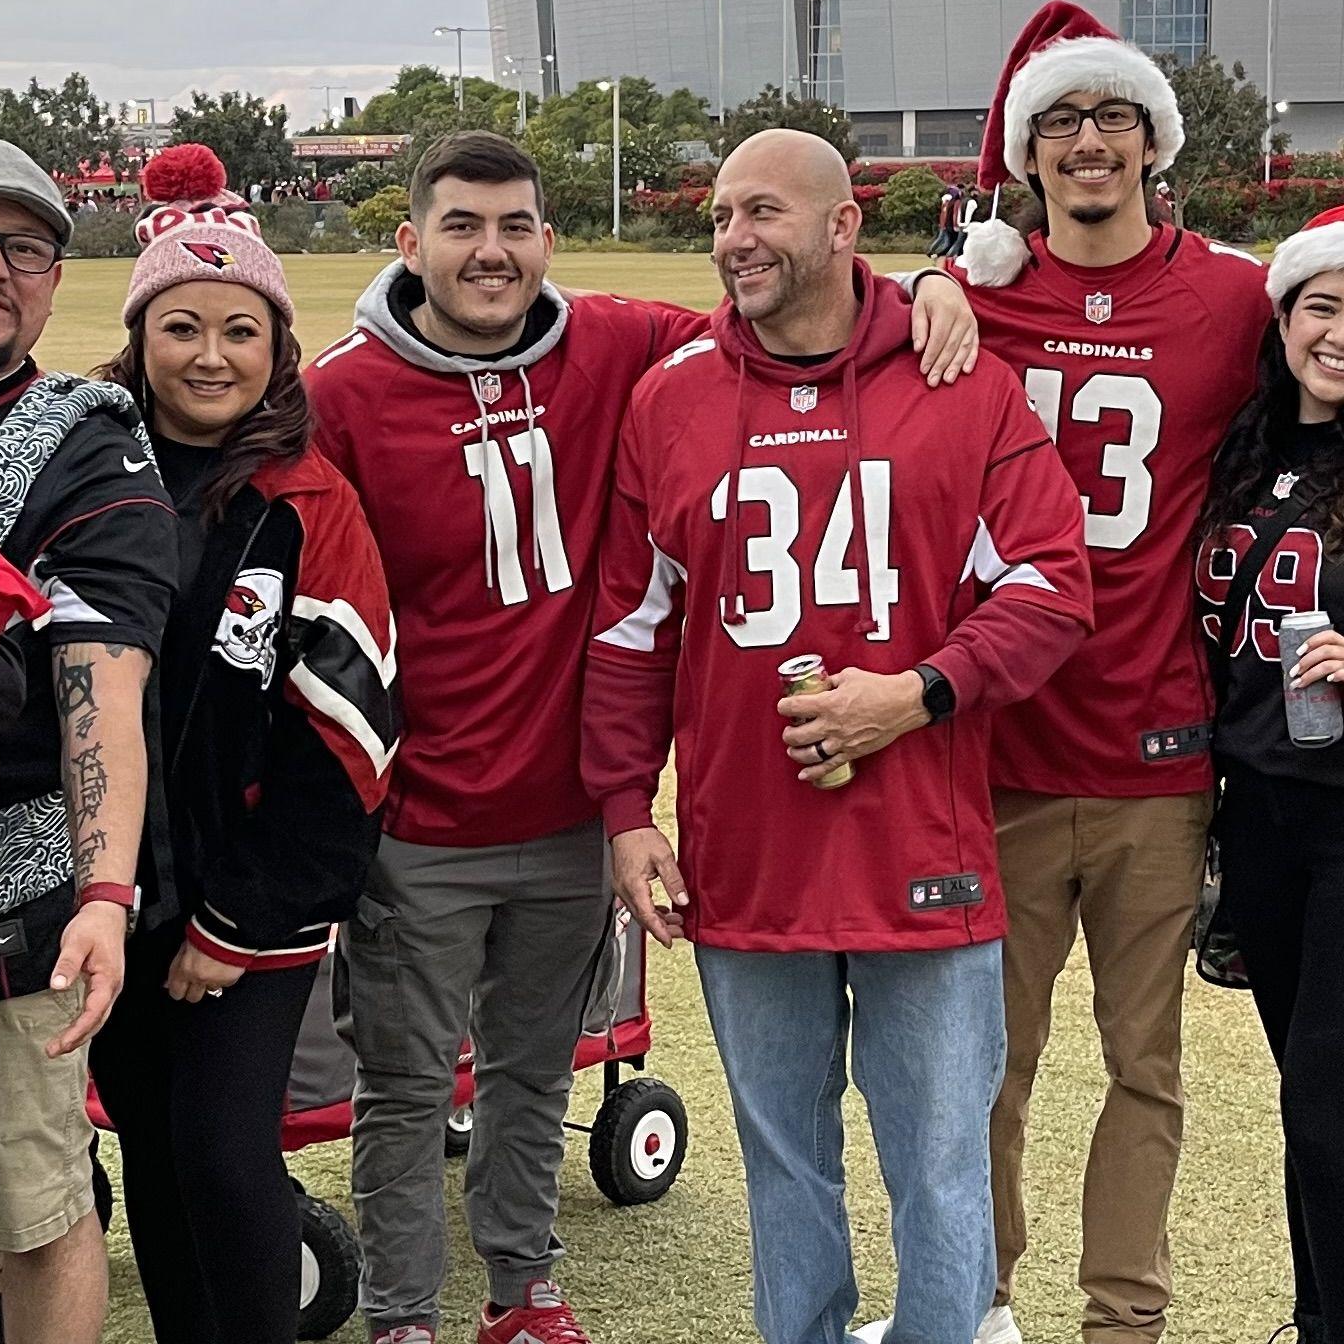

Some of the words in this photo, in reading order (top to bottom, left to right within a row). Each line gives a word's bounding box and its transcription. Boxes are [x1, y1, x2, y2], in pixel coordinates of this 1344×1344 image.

[1043, 340, 1153, 361] CARDINALS
[464, 427, 573, 606] 11
[711, 460, 899, 648] 34
[1195, 524, 1323, 663] 99
[950, 880, 966, 892] XL
